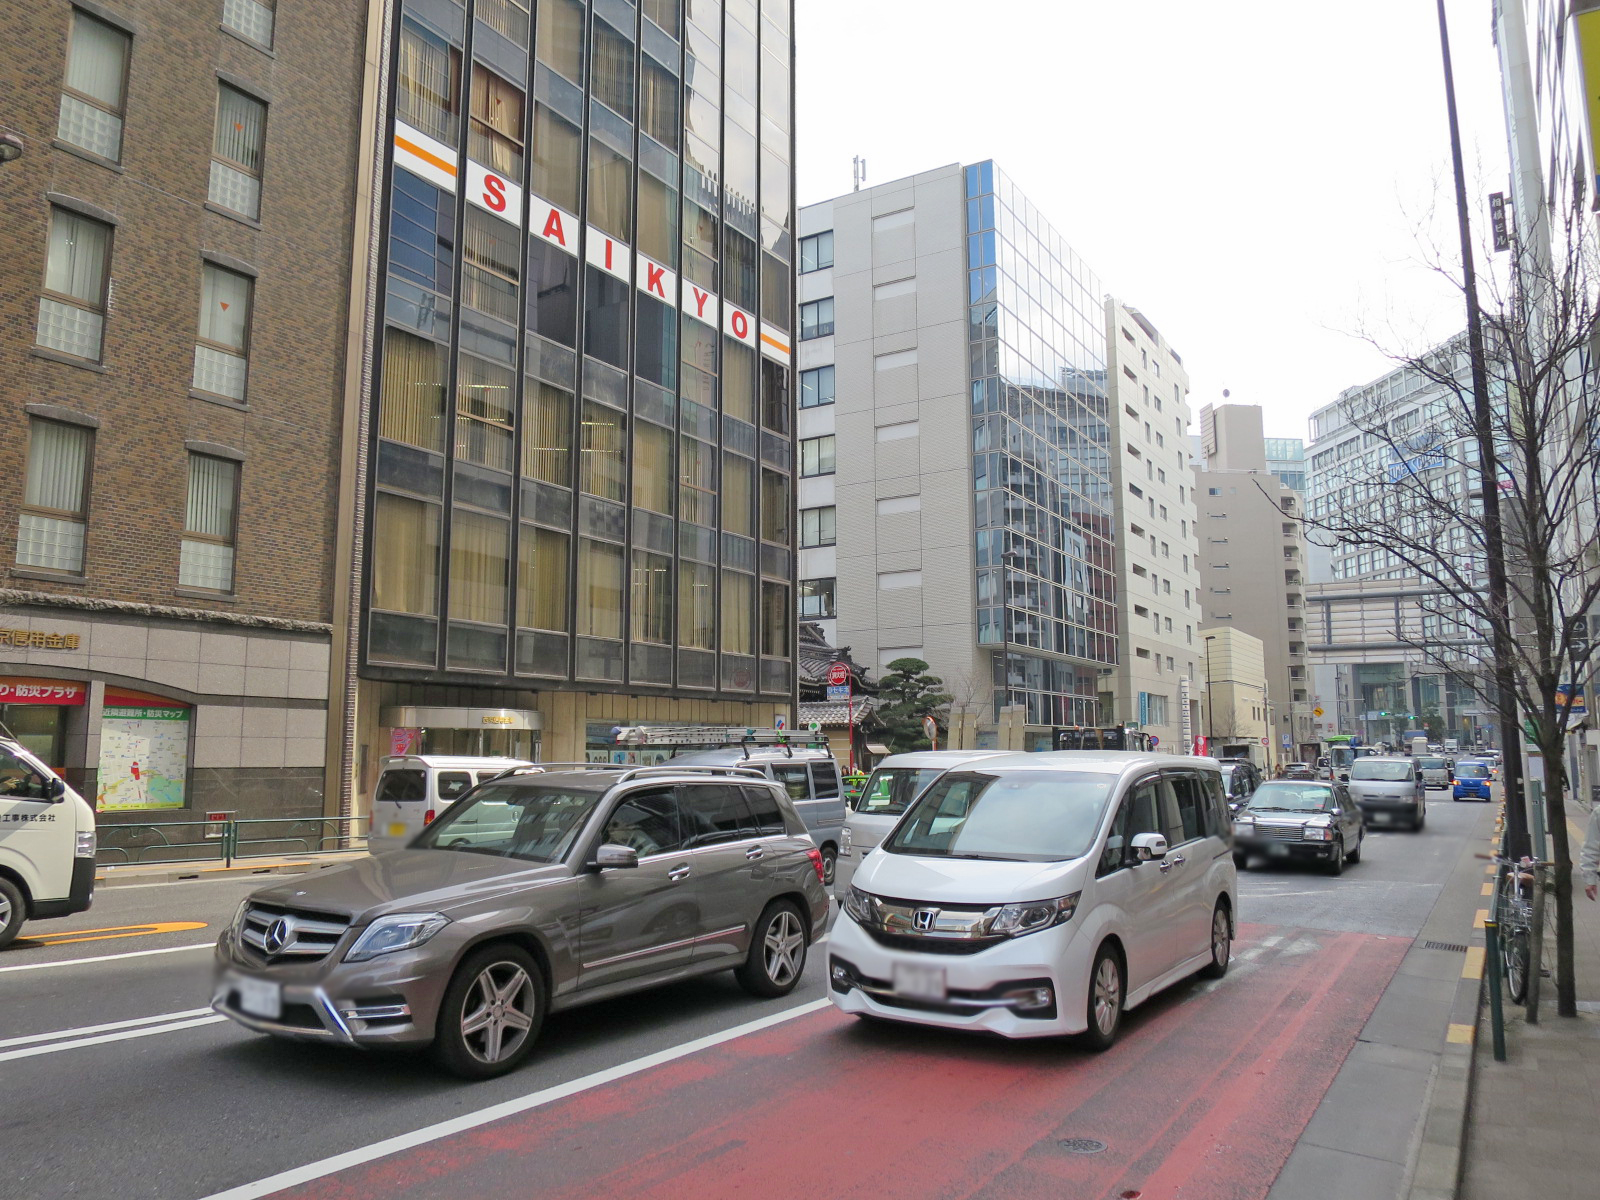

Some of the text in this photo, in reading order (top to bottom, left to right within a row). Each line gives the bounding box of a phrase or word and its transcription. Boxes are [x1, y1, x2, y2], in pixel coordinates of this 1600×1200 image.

[482, 173, 748, 339] SAIKYO
[0, 628, 80, 649] 京信用金庫
[0, 814, 56, 822] 工事株式会社
